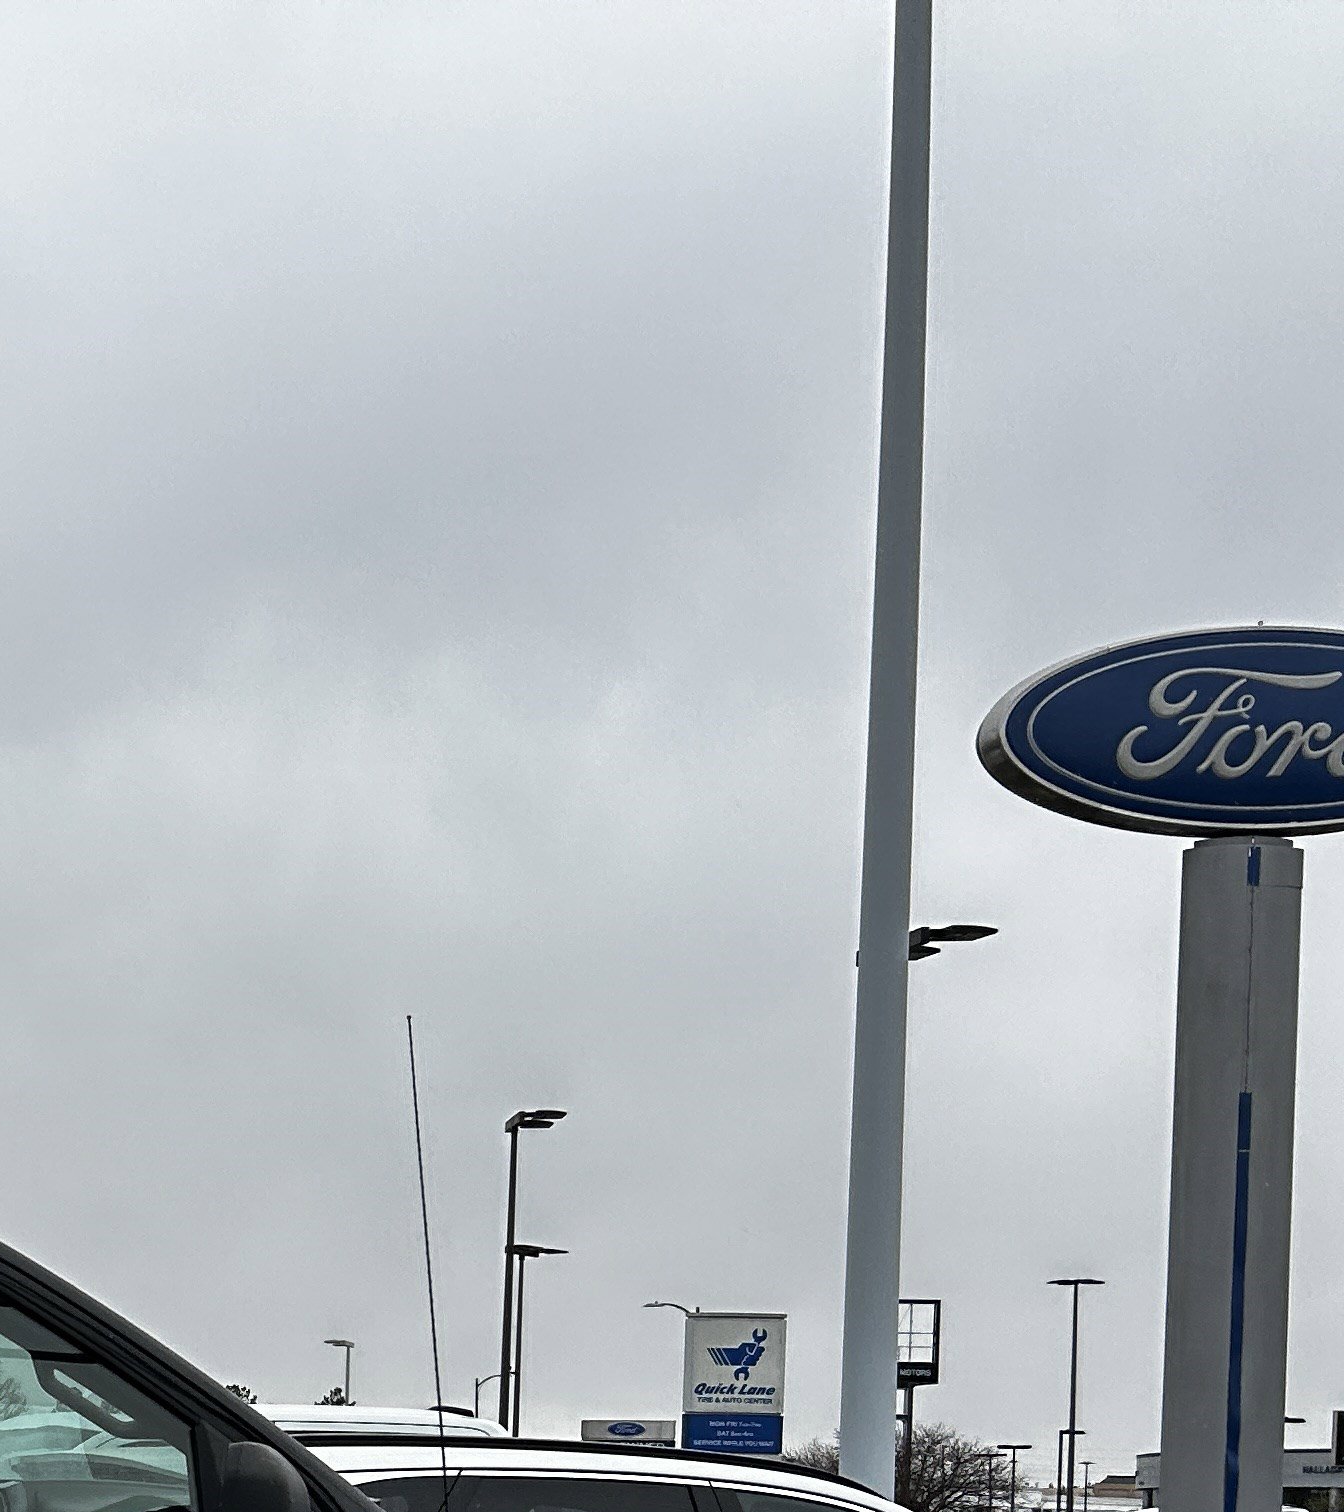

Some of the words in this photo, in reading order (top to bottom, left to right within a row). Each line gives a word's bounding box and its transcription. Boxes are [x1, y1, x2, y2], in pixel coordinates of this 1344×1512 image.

[899, 1368, 932, 1376] MOTORS
[694, 1382, 737, 1395] Quick
[738, 1383, 776, 1395] Lane
[744, 1397, 772, 1405] CENTER
